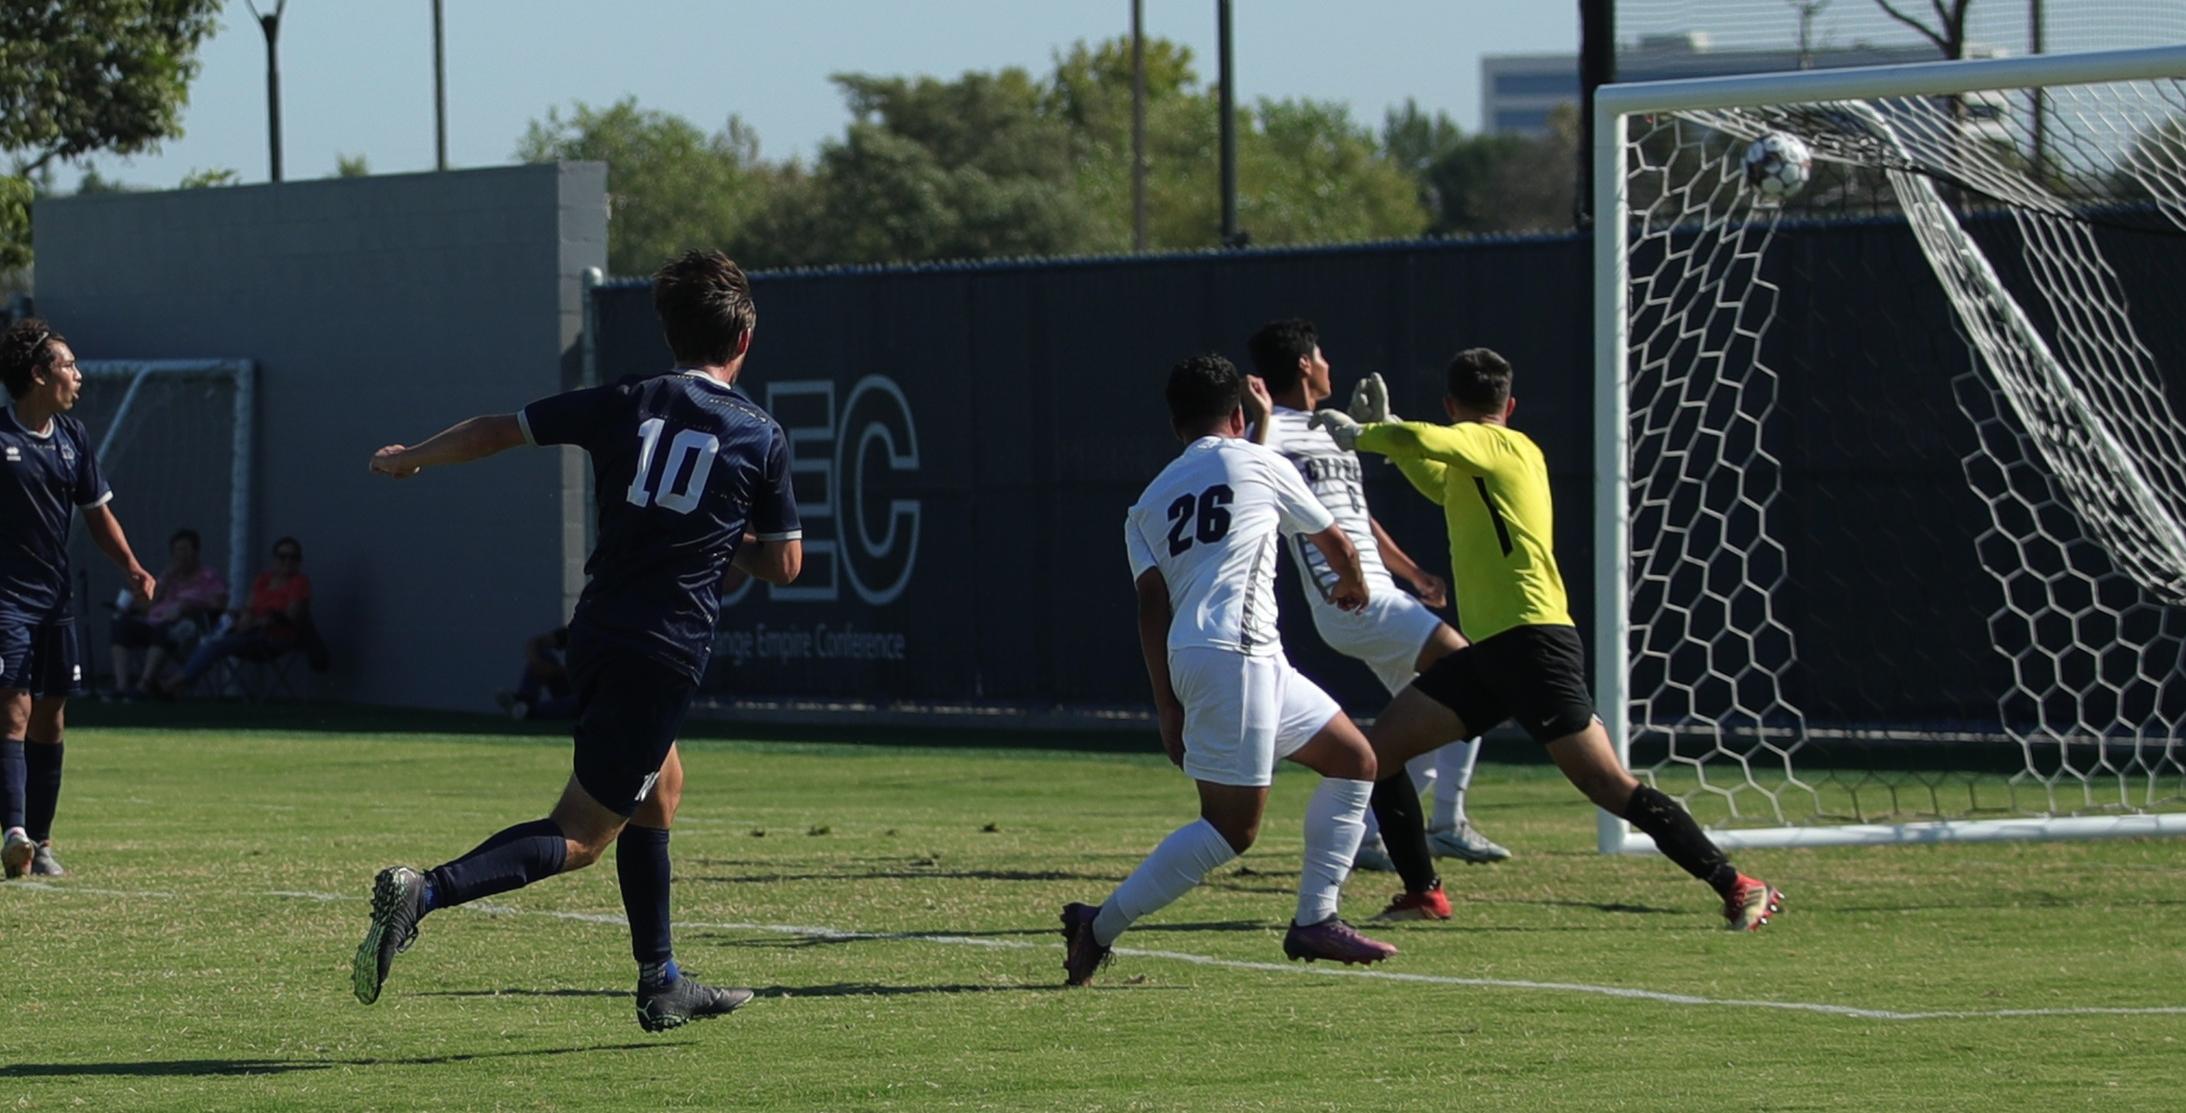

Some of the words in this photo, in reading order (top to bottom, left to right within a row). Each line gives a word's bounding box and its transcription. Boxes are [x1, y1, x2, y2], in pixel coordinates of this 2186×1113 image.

[626, 417, 720, 515] 10
[721, 374, 921, 607] EC
[1167, 483, 1235, 558] 26
[714, 629, 752, 666] ange
[757, 623, 812, 665] Empire
[816, 622, 906, 661] Conference
